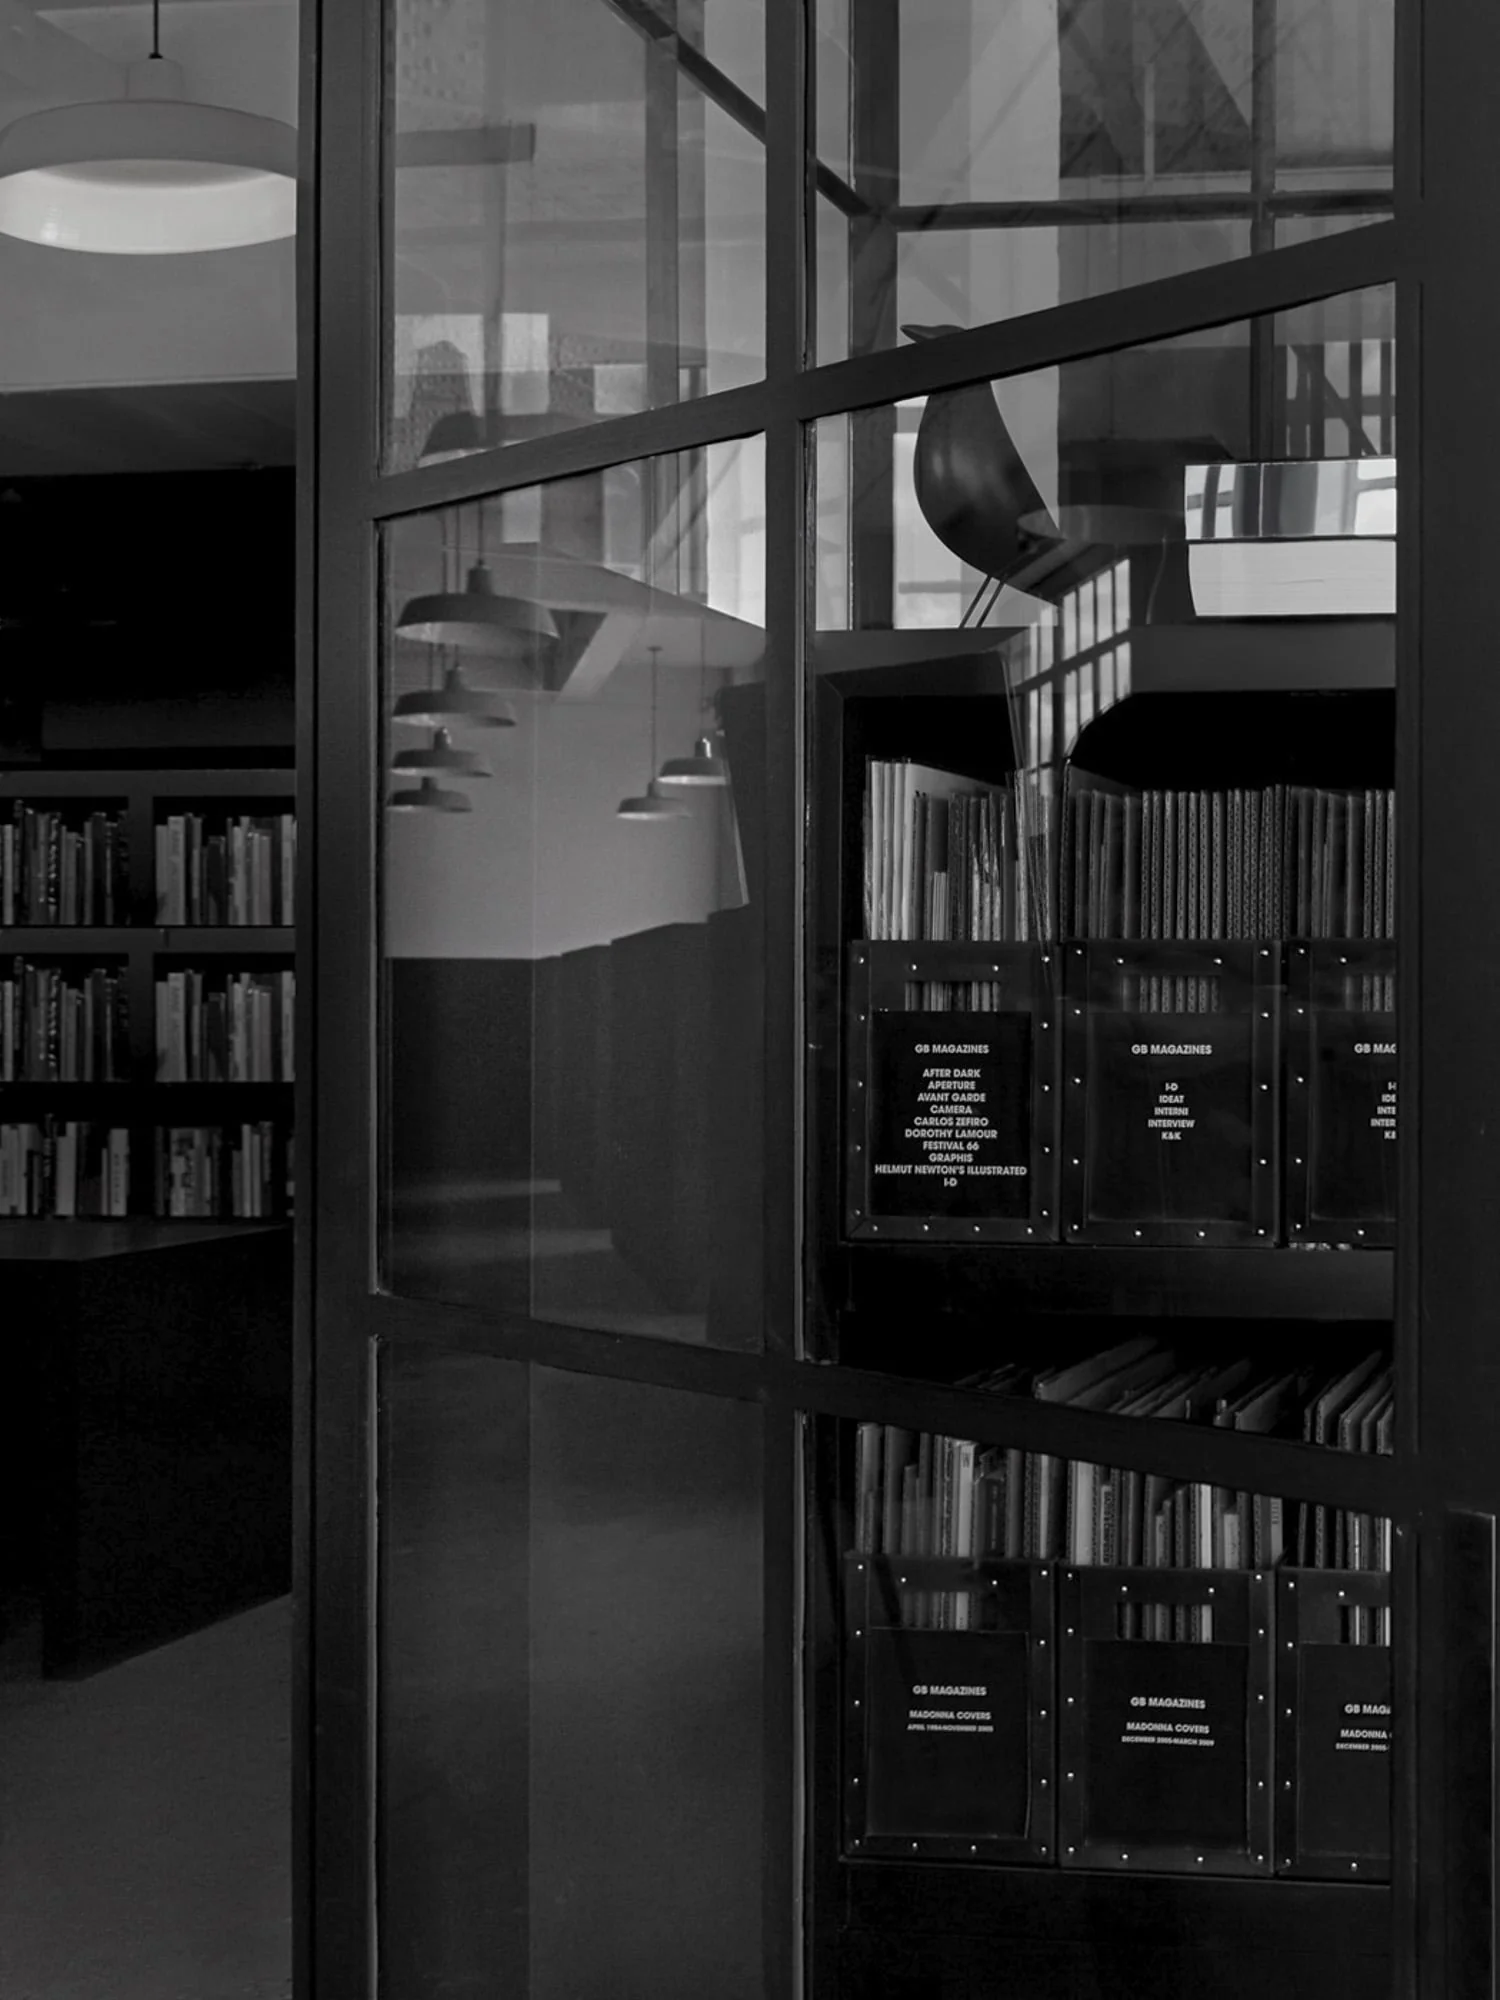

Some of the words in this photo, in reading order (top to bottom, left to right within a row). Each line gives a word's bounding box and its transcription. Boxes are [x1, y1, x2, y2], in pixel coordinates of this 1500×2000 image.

[915, 1044, 930, 1053] GB
[933, 1044, 989, 1053] MAGAZINES
[1131, 1044, 1148, 1054] GB
[1151, 1044, 1212, 1055] MAGAZINES
[1354, 1044, 1371, 1054] GB
[923, 1069, 951, 1077] AFTER
[954, 1069, 981, 1077] DARK
[928, 1081, 976, 1089] APERTURE
[917, 1093, 949, 1102] AVANT
[952, 1093, 985, 1102] GARDE
[1159, 1095, 1185, 1103] IDEAT
[930, 1105, 972, 1114] CAMERA
[914, 1117, 953, 1126] CARLOS
[956, 1117, 989, 1126] ZEFIRO
[1148, 1120, 1195, 1128] INTERVIEW
[905, 1129, 952, 1138] DOROTHY
[955, 1129, 997, 1138] LAMOUR
[923, 1141, 964, 1150] FESTIVAL
[967, 1141, 979, 1151] 66
[929, 1153, 973, 1162] GRAPHIS
[875, 1165, 912, 1174] HELMUT
[915, 1165, 965, 1174] NEWTON'S
[967, 1166, 1027, 1175] ILLUSTRATED
[913, 1685, 928, 1694] GB
[930, 1685, 987, 1696] MAGAZINES
[1130, 1697, 1146, 1706] GB
[1148, 1697, 1205, 1709] MAGAZINES
[1345, 1704, 1360, 1714] GB
[909, 1710, 955, 1719] MADONNA
[956, 1711, 991, 1720] COVERS
[1126, 1722, 1173, 1732] MADONNA
[1175, 1724, 1209, 1734] COVERS
[1340, 1729, 1387, 1739] MADONNA
